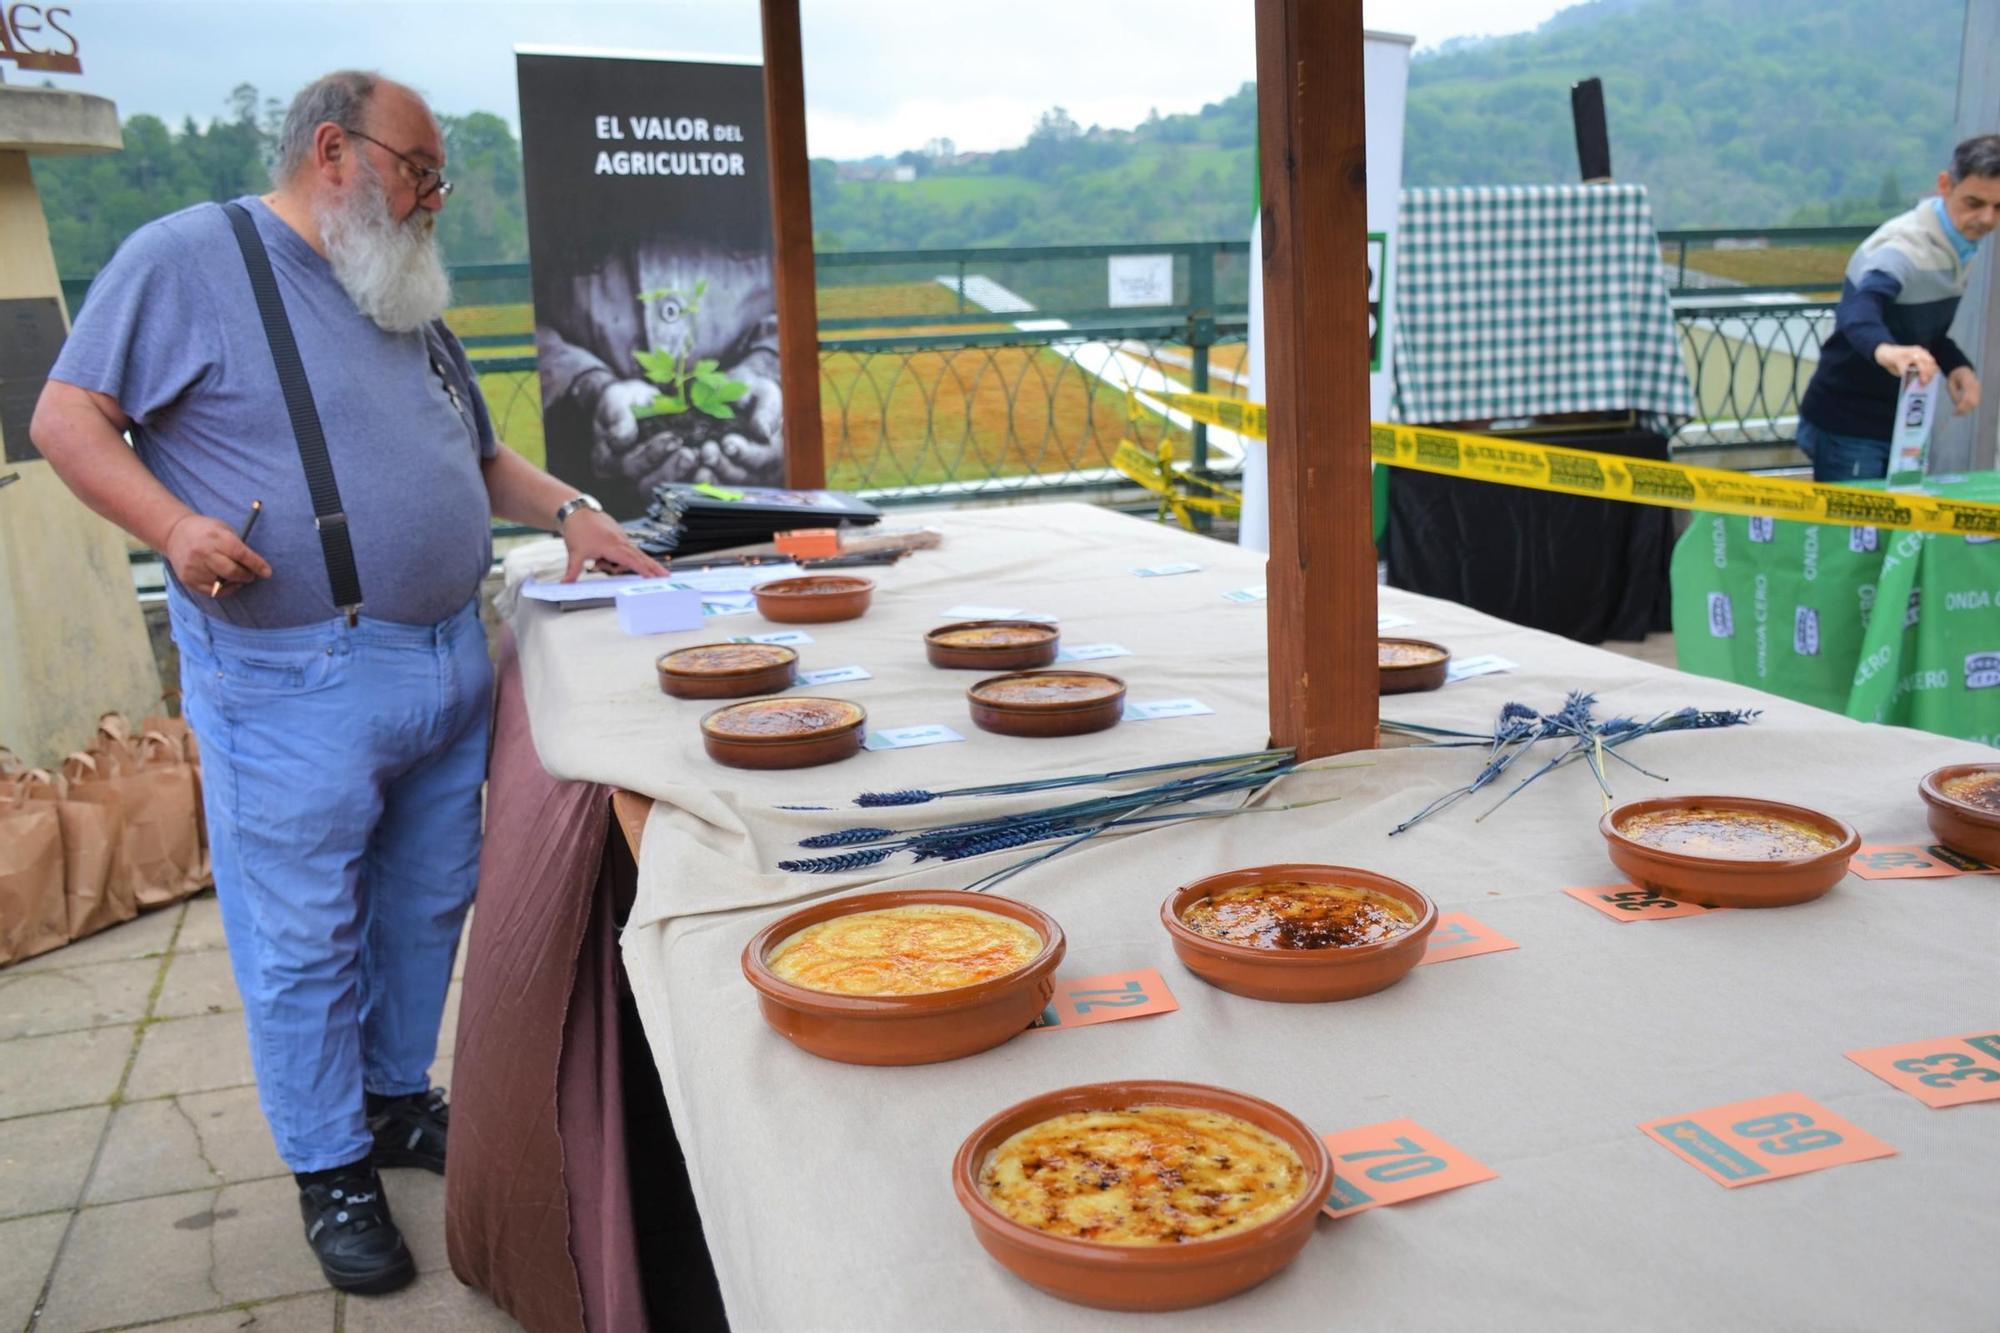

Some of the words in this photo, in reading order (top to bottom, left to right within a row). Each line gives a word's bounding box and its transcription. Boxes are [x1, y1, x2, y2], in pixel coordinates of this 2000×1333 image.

[595, 115, 624, 139] EL
[629, 116, 709, 141] VALOR
[713, 124, 744, 142] DEL
[594, 151, 745, 176] AGRICULTOR
[1712, 516, 1727, 569] ONDA
[1803, 525, 1819, 581] ONDA
[1755, 573, 1769, 622] CERO
[1945, 591, 1990, 611] ONDA
[1600, 891, 1679, 911] 35
[1069, 980, 1149, 1014] 72
[1893, 1053, 2000, 1088] 33
[1731, 1111, 1843, 1155] 69
[1339, 1136, 1448, 1182] 70
